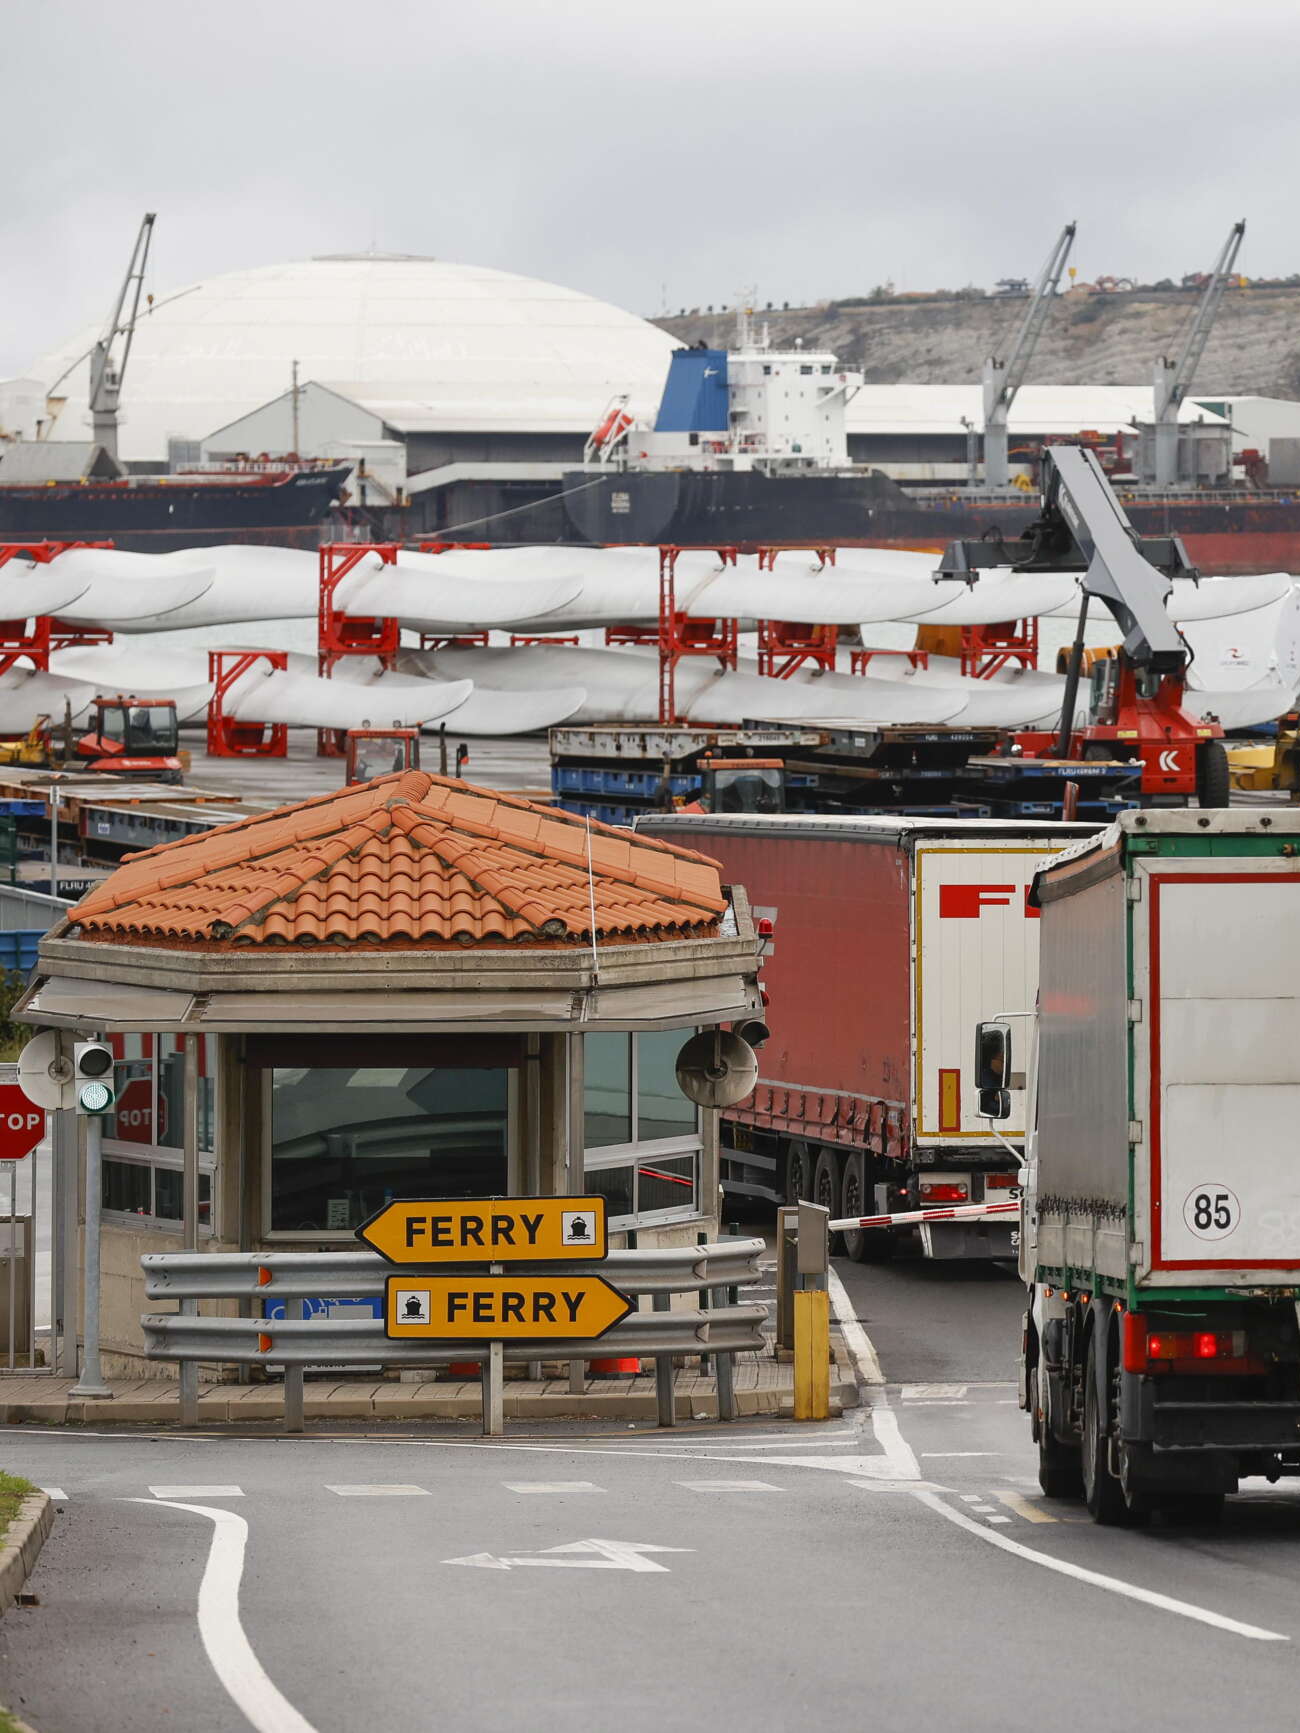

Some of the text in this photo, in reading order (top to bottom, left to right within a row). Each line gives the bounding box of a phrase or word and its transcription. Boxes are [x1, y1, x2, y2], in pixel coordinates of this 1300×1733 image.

[1194, 1193, 1231, 1230] 85
[405, 1214, 544, 1247] FERRY
[447, 1291, 586, 1322] FERRY
